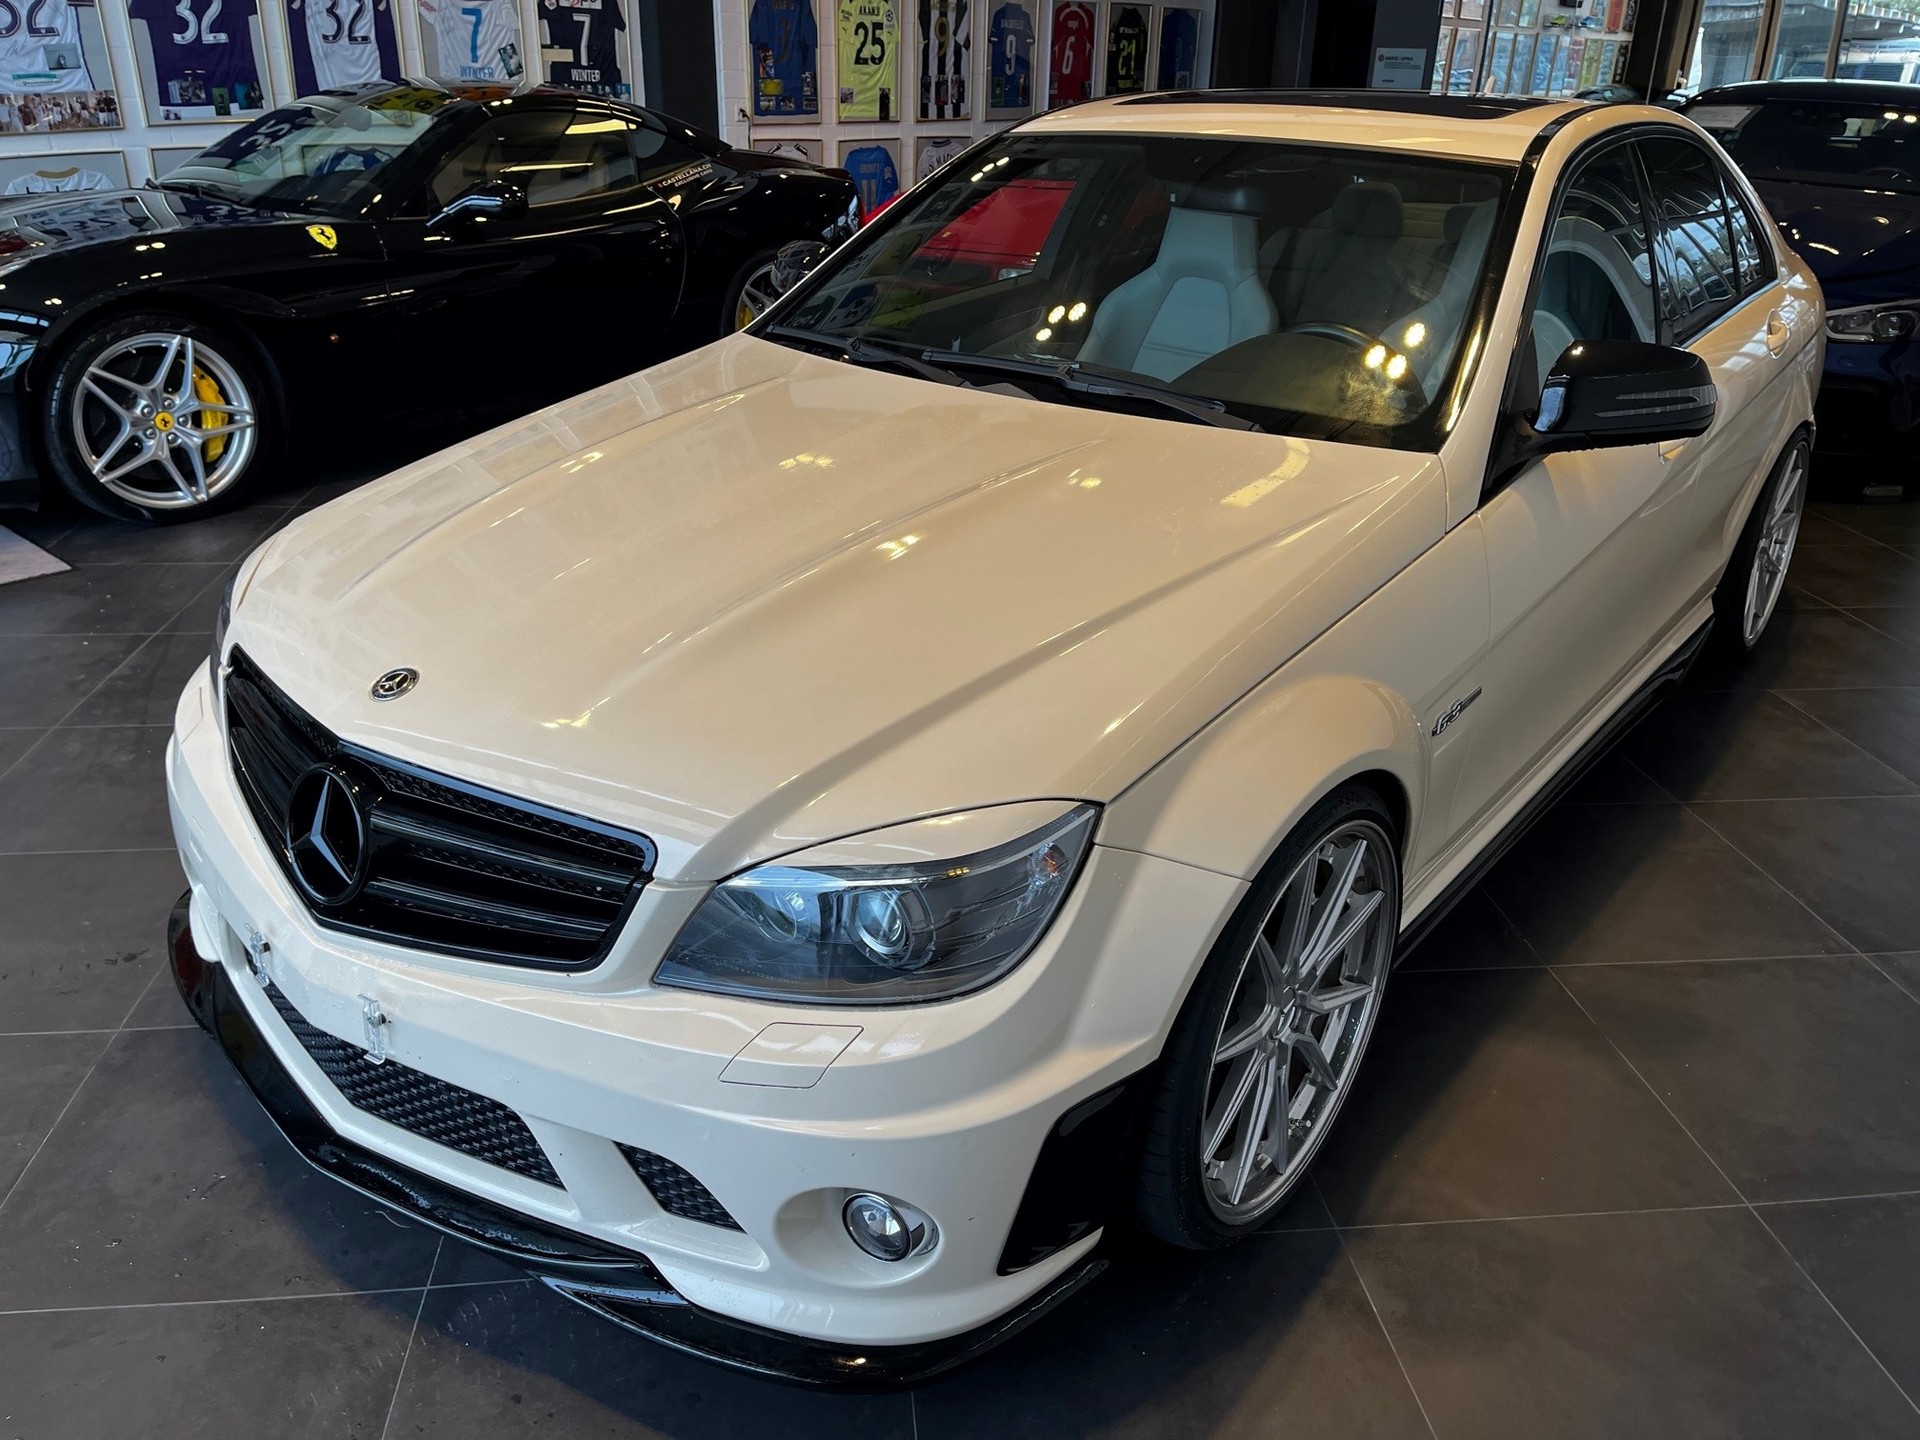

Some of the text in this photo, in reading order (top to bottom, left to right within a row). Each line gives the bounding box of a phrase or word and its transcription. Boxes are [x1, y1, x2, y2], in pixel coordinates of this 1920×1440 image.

[172, 0, 230, 44] 32
[322, 0, 372, 45] 32
[461, 7, 482, 63] 7
[572, 13, 591, 66] 7
[934, 16, 950, 57] 9
[854, 21, 886, 65] 25
[1005, 34, 1017, 76] 9
[1062, 36, 1076, 75] 6
[1118, 39, 1137, 76] 21
[459, 65, 495, 80] WINTER
[570, 68, 601, 83] WINTER
[674, 168, 713, 188] EXCLUSIVE CARS
